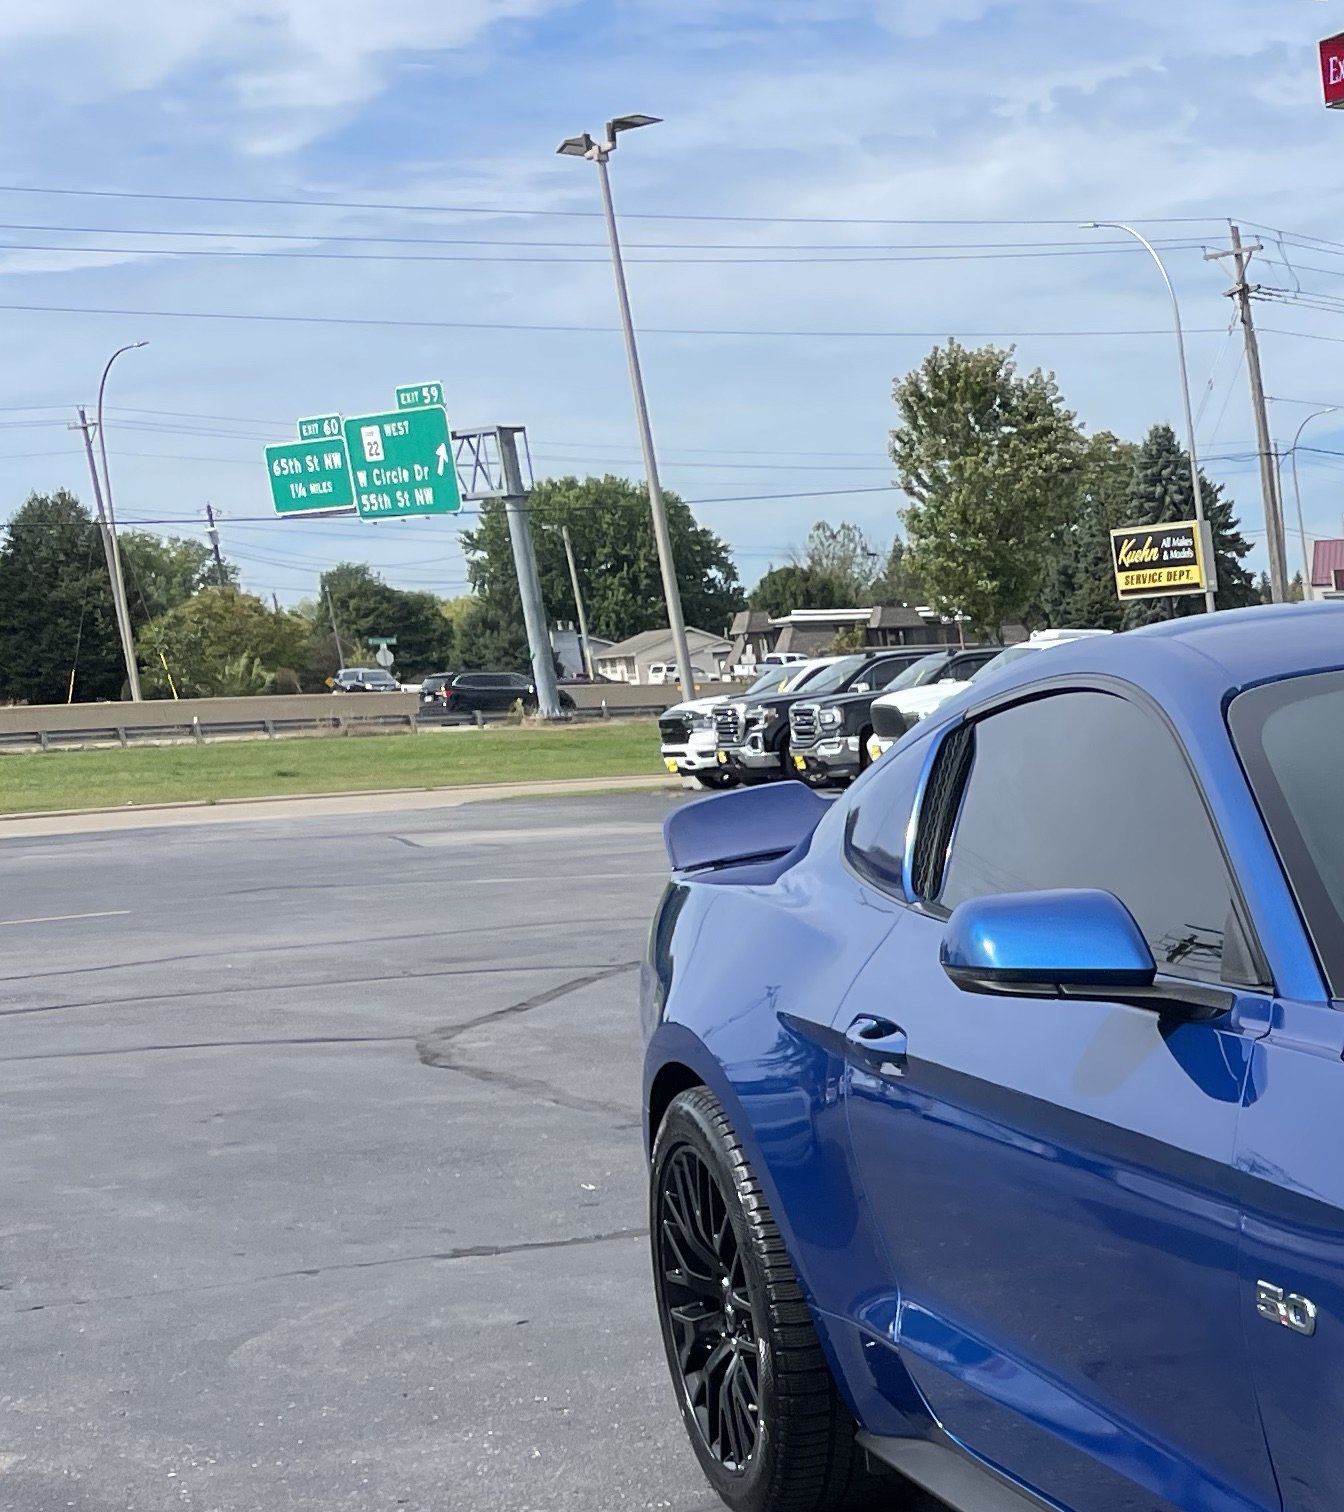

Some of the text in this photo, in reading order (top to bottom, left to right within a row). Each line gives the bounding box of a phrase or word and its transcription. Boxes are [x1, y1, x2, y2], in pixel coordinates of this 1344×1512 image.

[401, 386, 440, 405] EXIT 59
[302, 418, 339, 437] EXIT 60
[383, 420, 411, 438] WEST
[367, 441, 381, 457] 22
[272, 452, 342, 477] 65th St NW
[356, 463, 430, 488] W Circle Dr
[309, 481, 334, 495] MILES
[361, 486, 434, 512] 55th St NW
[1161, 535, 1194, 549] All Makes
[1118, 535, 1160, 568] Kuehn
[1162, 550, 1169, 560] &
[1124, 569, 1194, 586] SERVICE DEPT.
